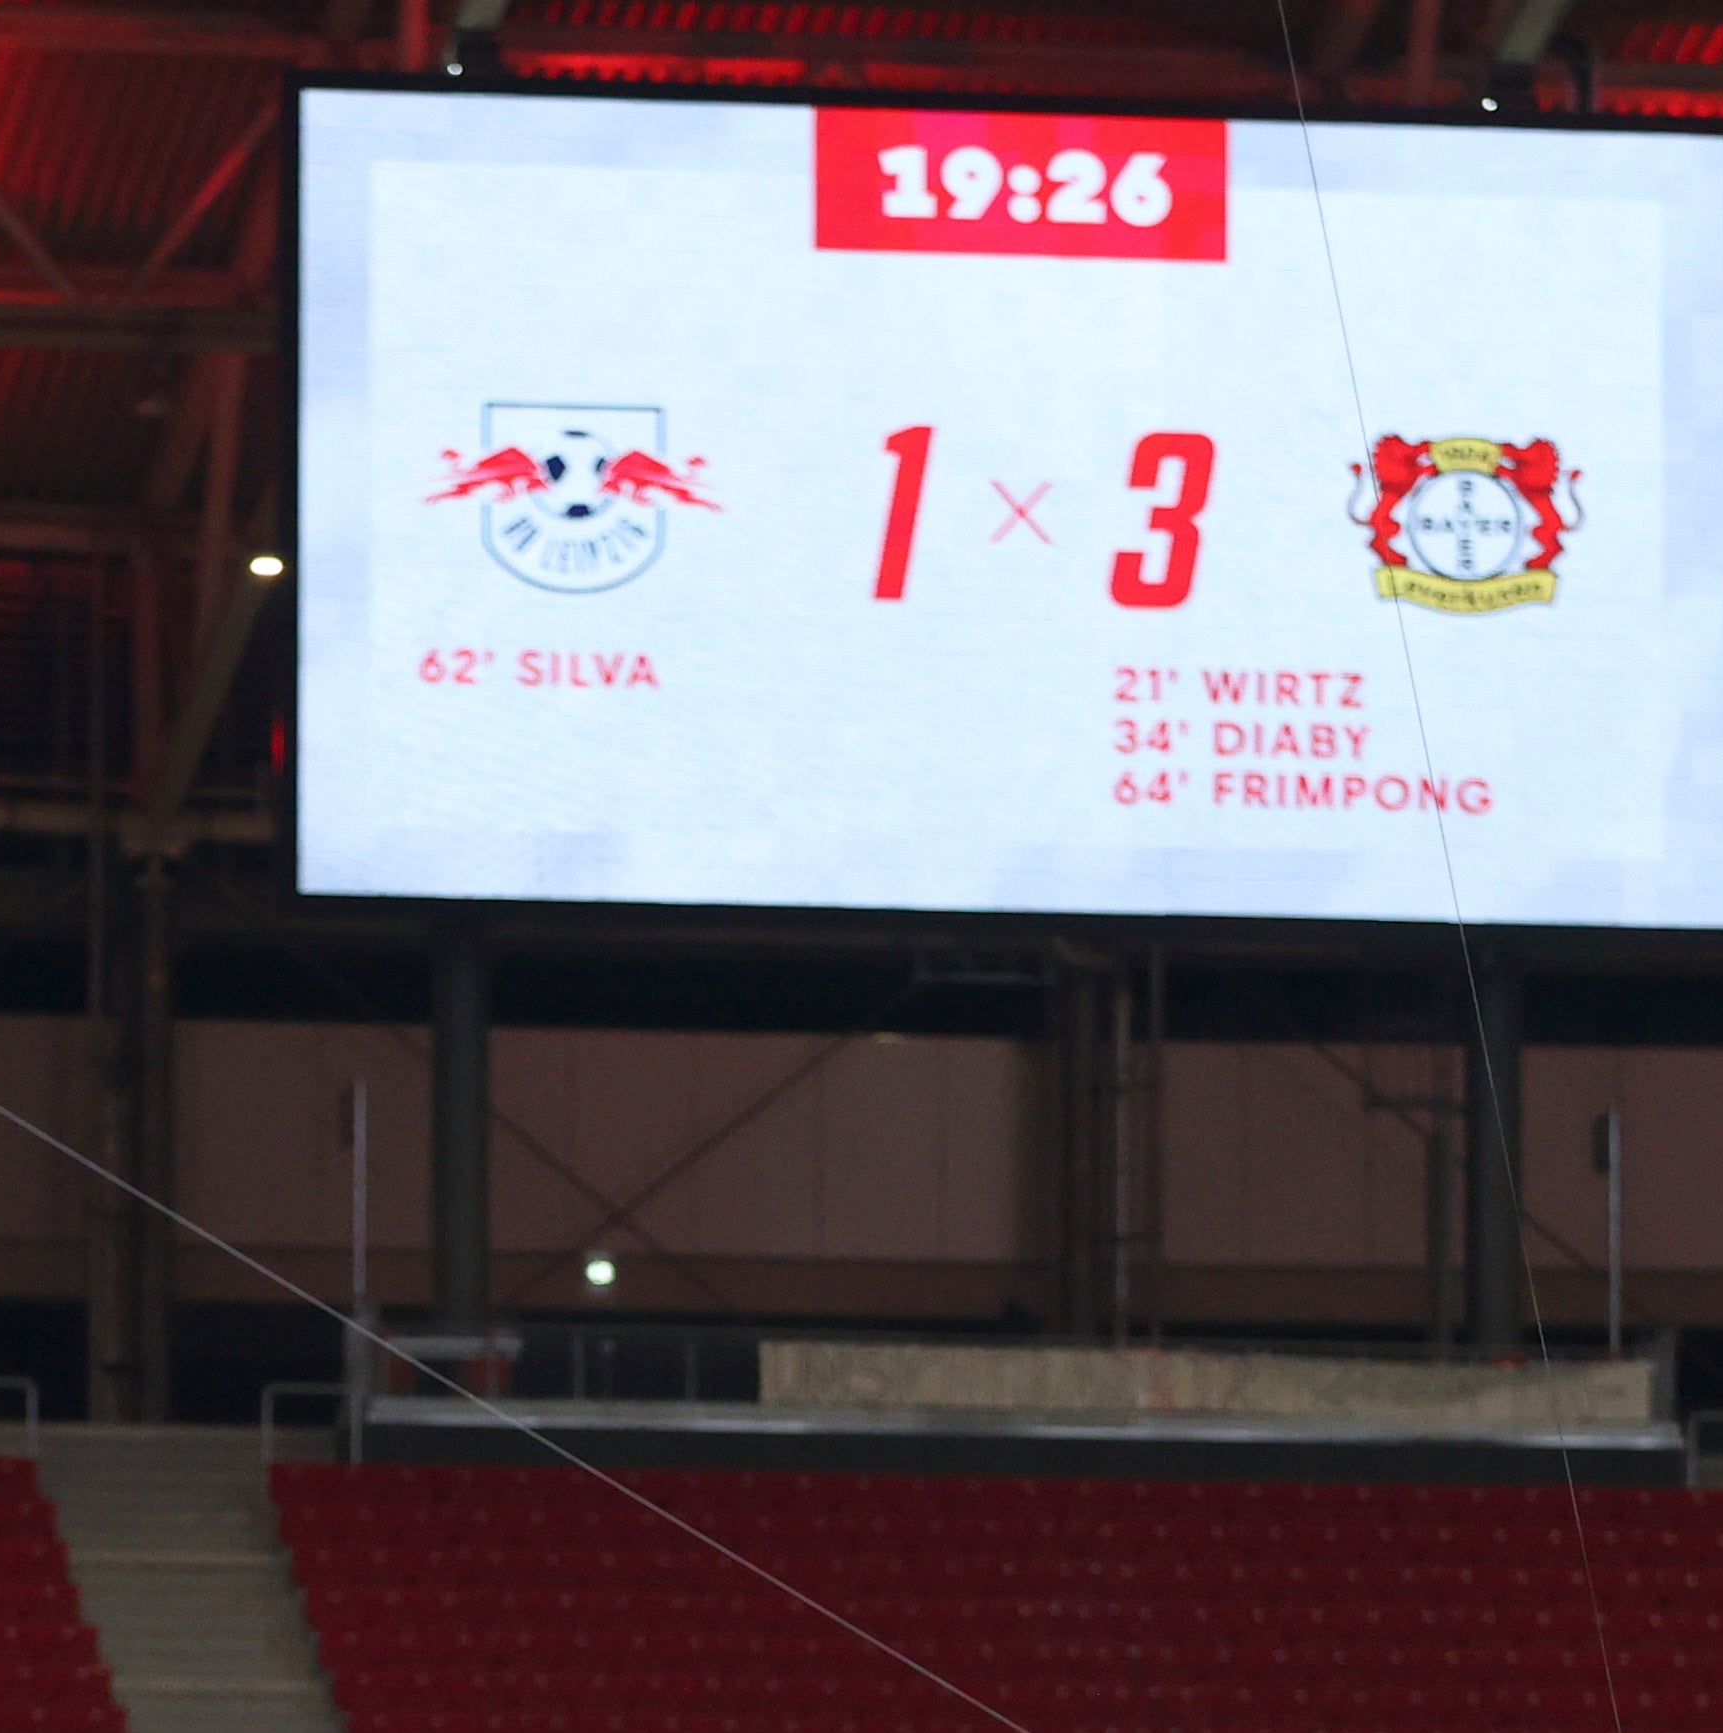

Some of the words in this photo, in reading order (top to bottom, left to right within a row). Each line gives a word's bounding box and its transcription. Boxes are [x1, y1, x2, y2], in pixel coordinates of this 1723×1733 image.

[878, 144, 1173, 227] 19:26
[873, 425, 936, 600] 1
[1110, 431, 1216, 608] 3
[516, 649, 659, 690] SILVA
[1202, 669, 1365, 709] WIRTZ
[1213, 720, 1370, 760] DIABY
[1213, 772, 1493, 816] FRIMPONG
